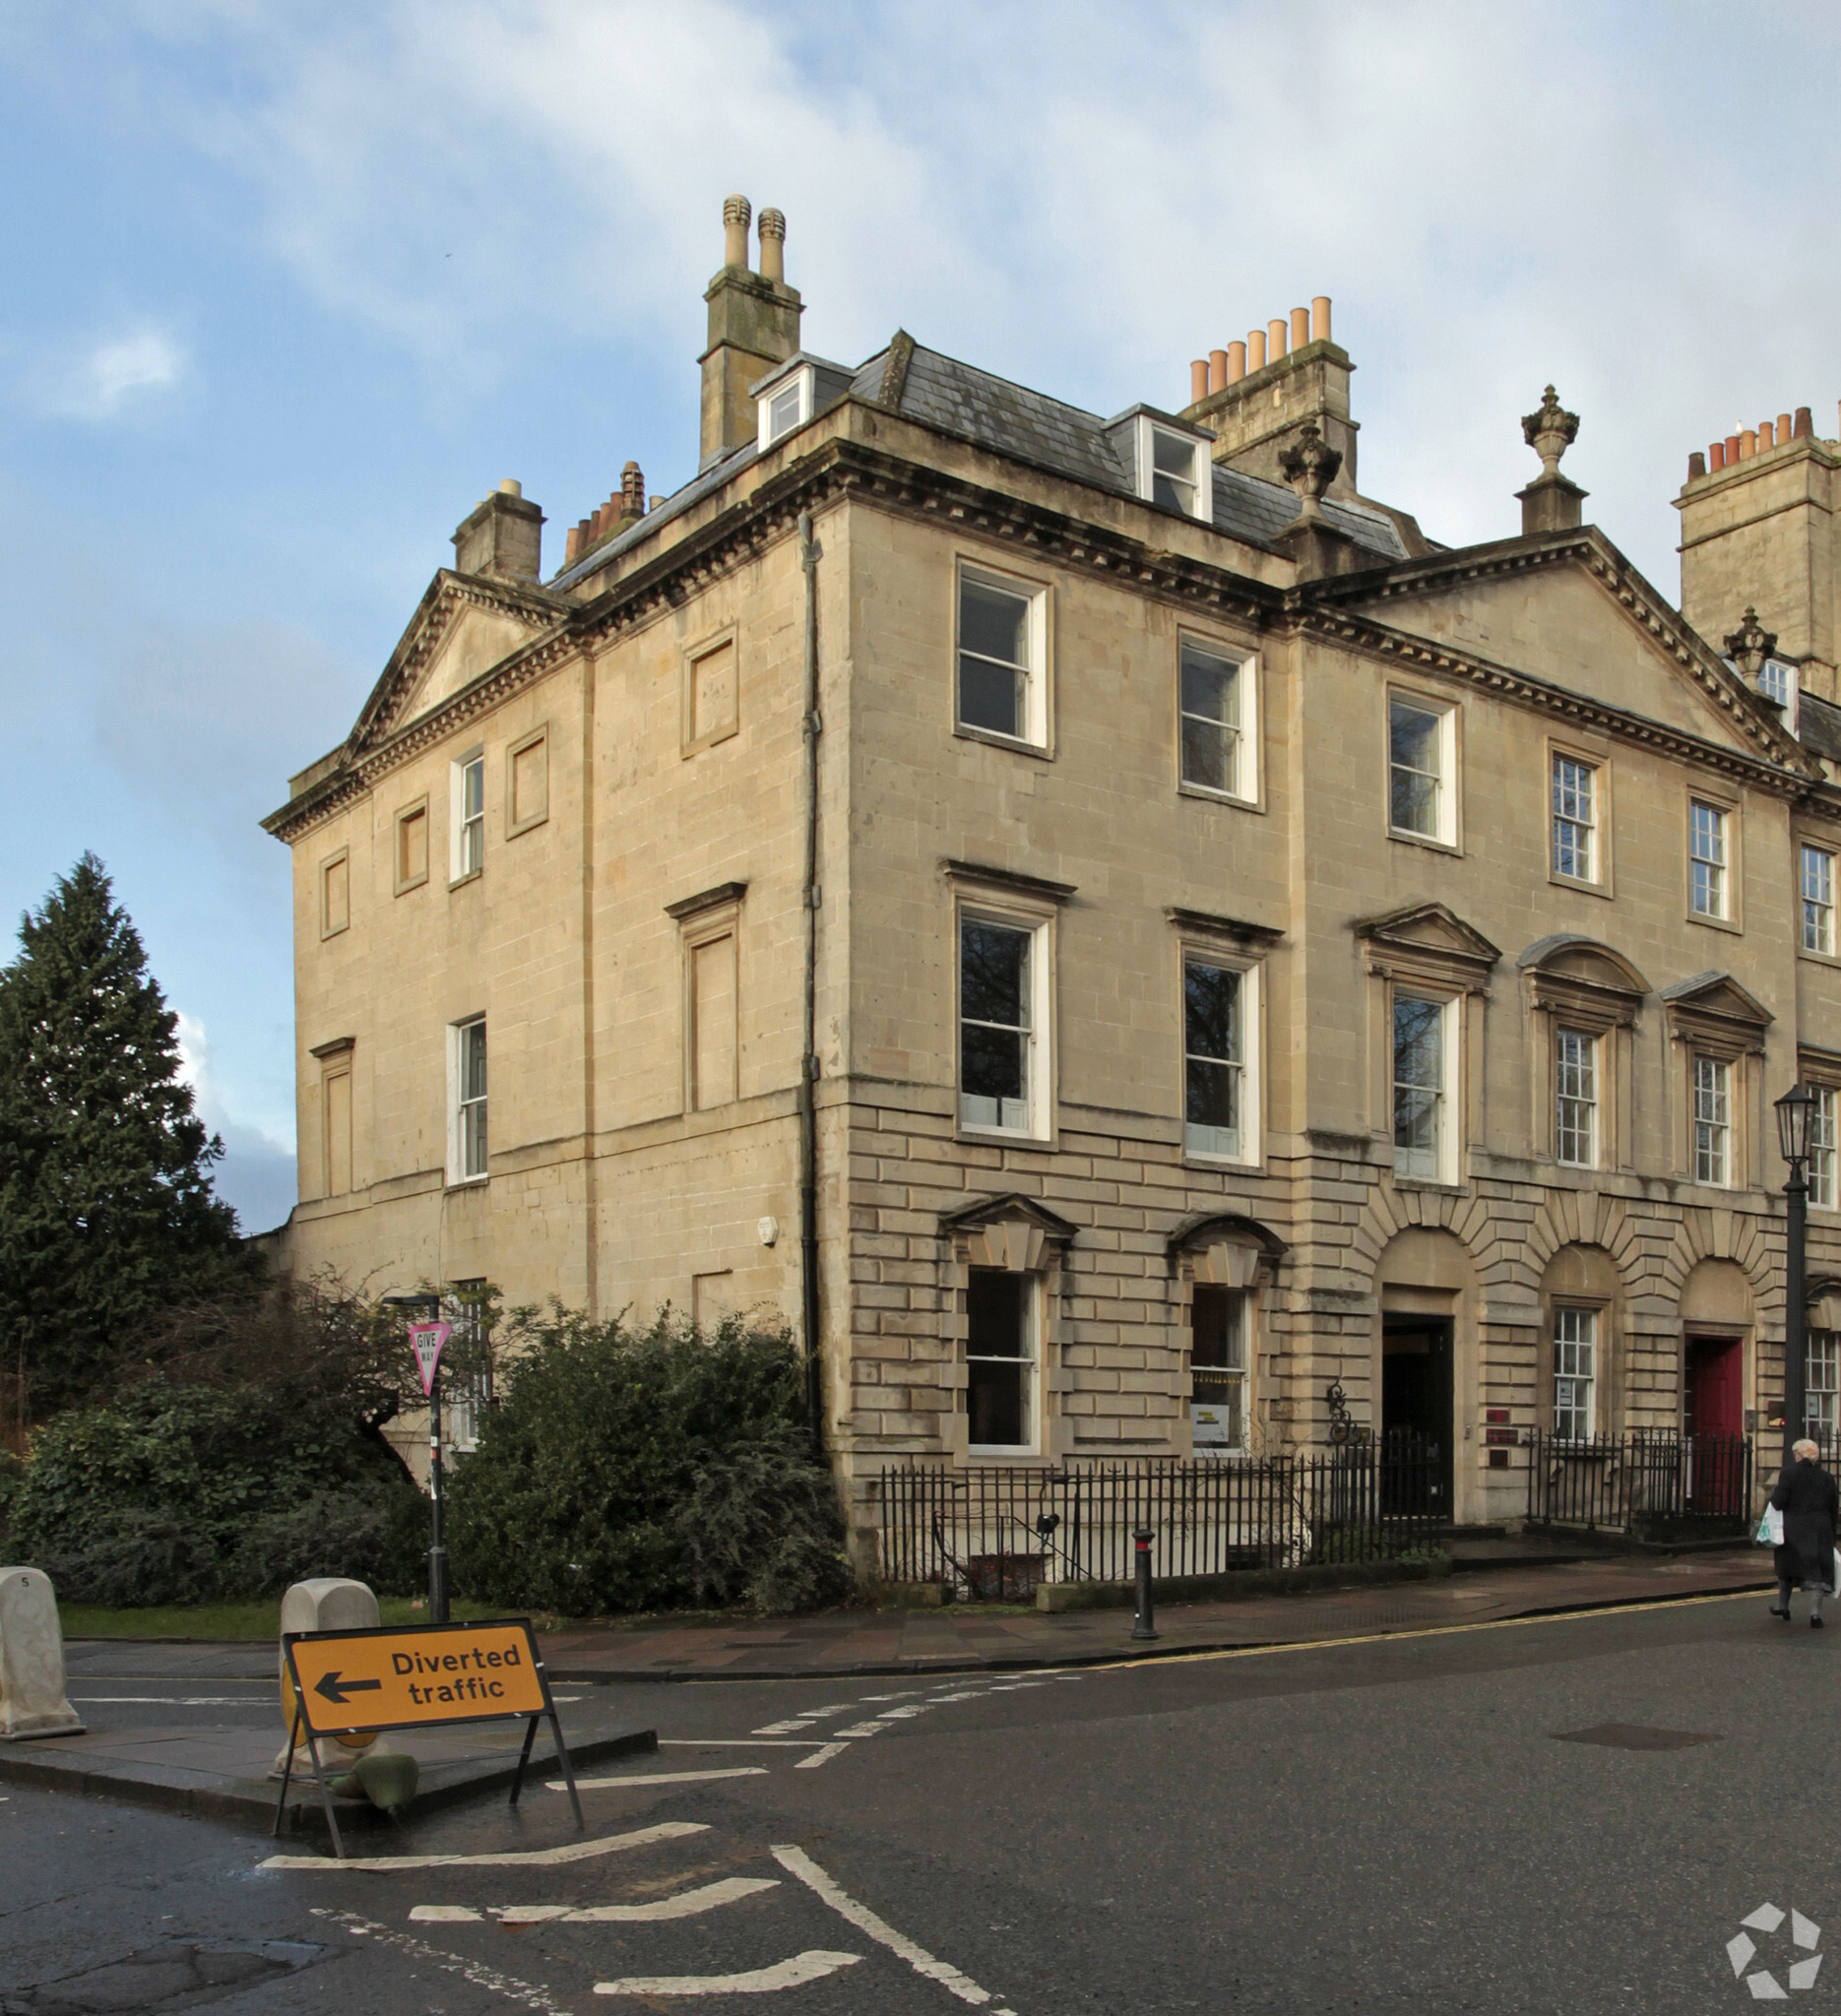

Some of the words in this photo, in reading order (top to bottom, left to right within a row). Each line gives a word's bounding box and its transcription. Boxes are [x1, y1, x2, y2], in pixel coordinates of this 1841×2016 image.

[417, 1333, 436, 1348] GIVE
[421, 1353, 434, 1361] WAY
[21, 1576, 31, 1588] 5
[391, 1644, 521, 1675] Diverted
[408, 1676, 505, 1705] traffic
